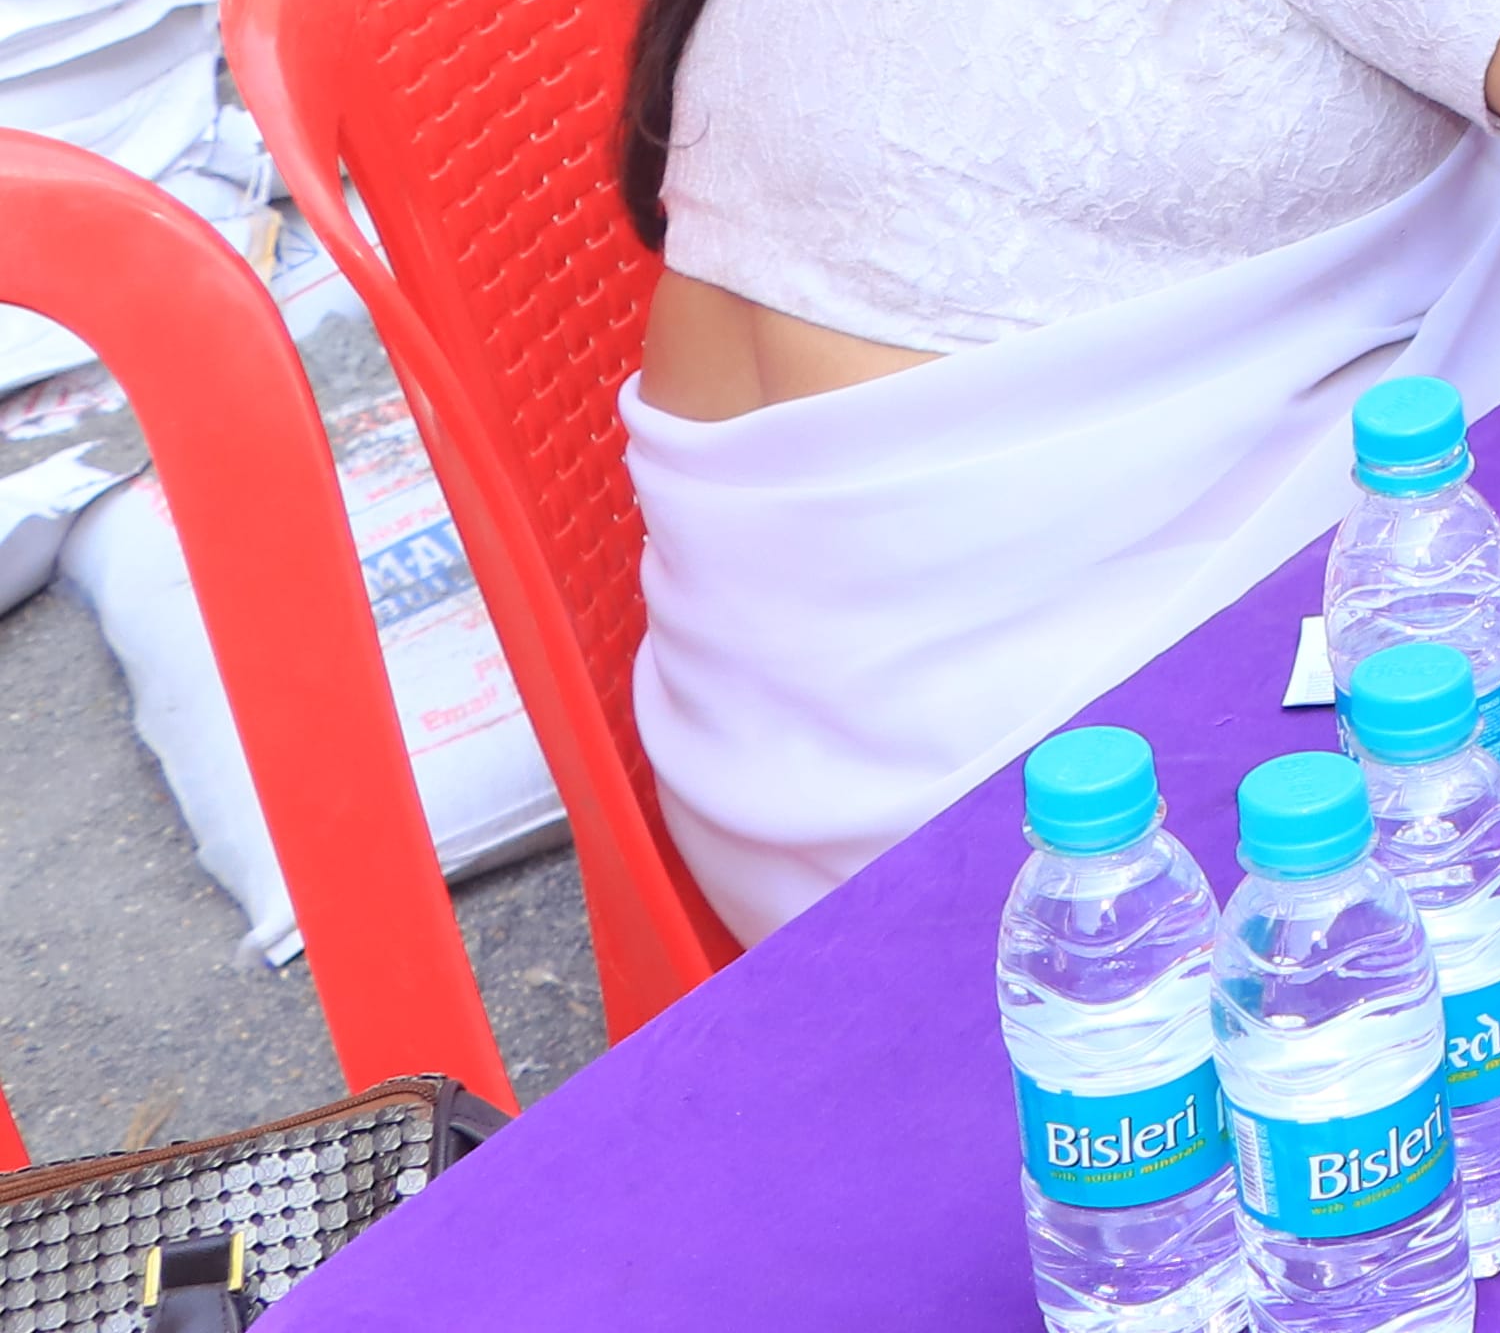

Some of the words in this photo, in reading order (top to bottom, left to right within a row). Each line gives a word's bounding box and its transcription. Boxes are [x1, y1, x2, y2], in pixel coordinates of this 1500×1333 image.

[1045, 1094, 1198, 1168] Bisleri
[1140, 1137, 1207, 1175] minerals
[1308, 1092, 1446, 1201] Bisleri
[1311, 1202, 1346, 1215] with
